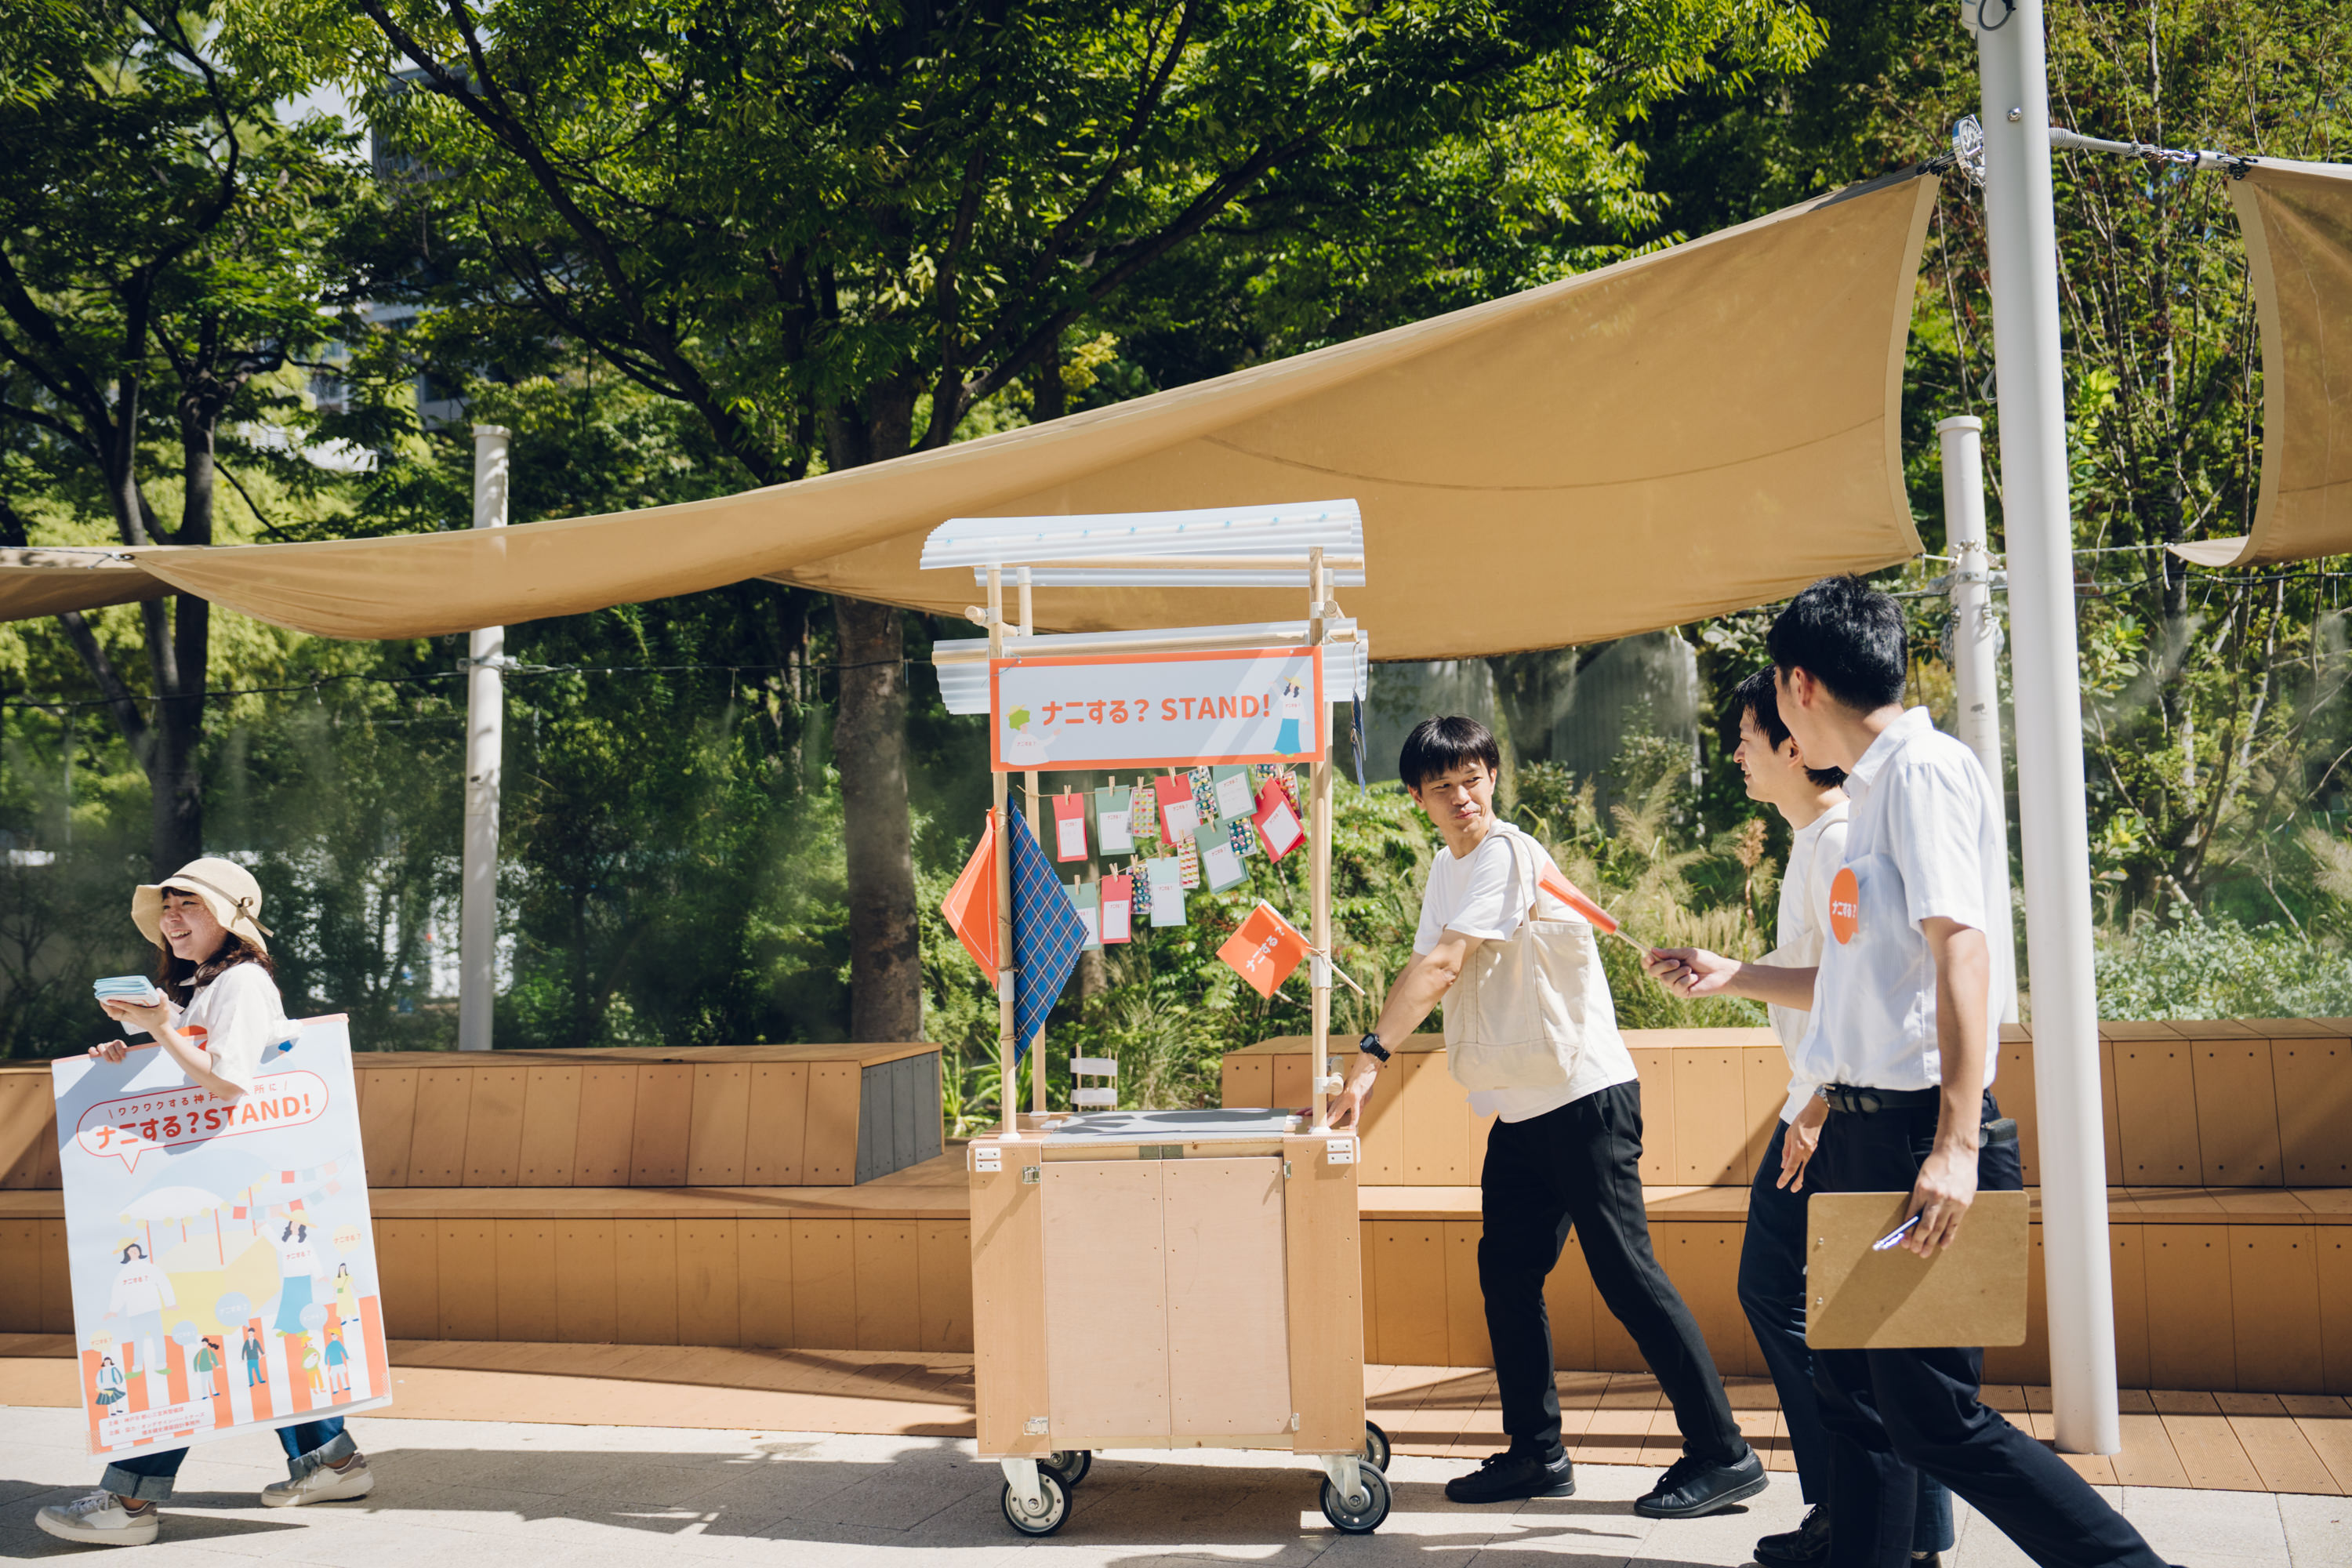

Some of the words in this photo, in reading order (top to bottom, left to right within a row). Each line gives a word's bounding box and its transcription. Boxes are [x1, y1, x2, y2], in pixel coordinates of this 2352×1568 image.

[1042, 699, 1150, 726] ナニする？
[1160, 694, 1271, 721] STAND!
[1246, 926, 1285, 973] ナニする？
